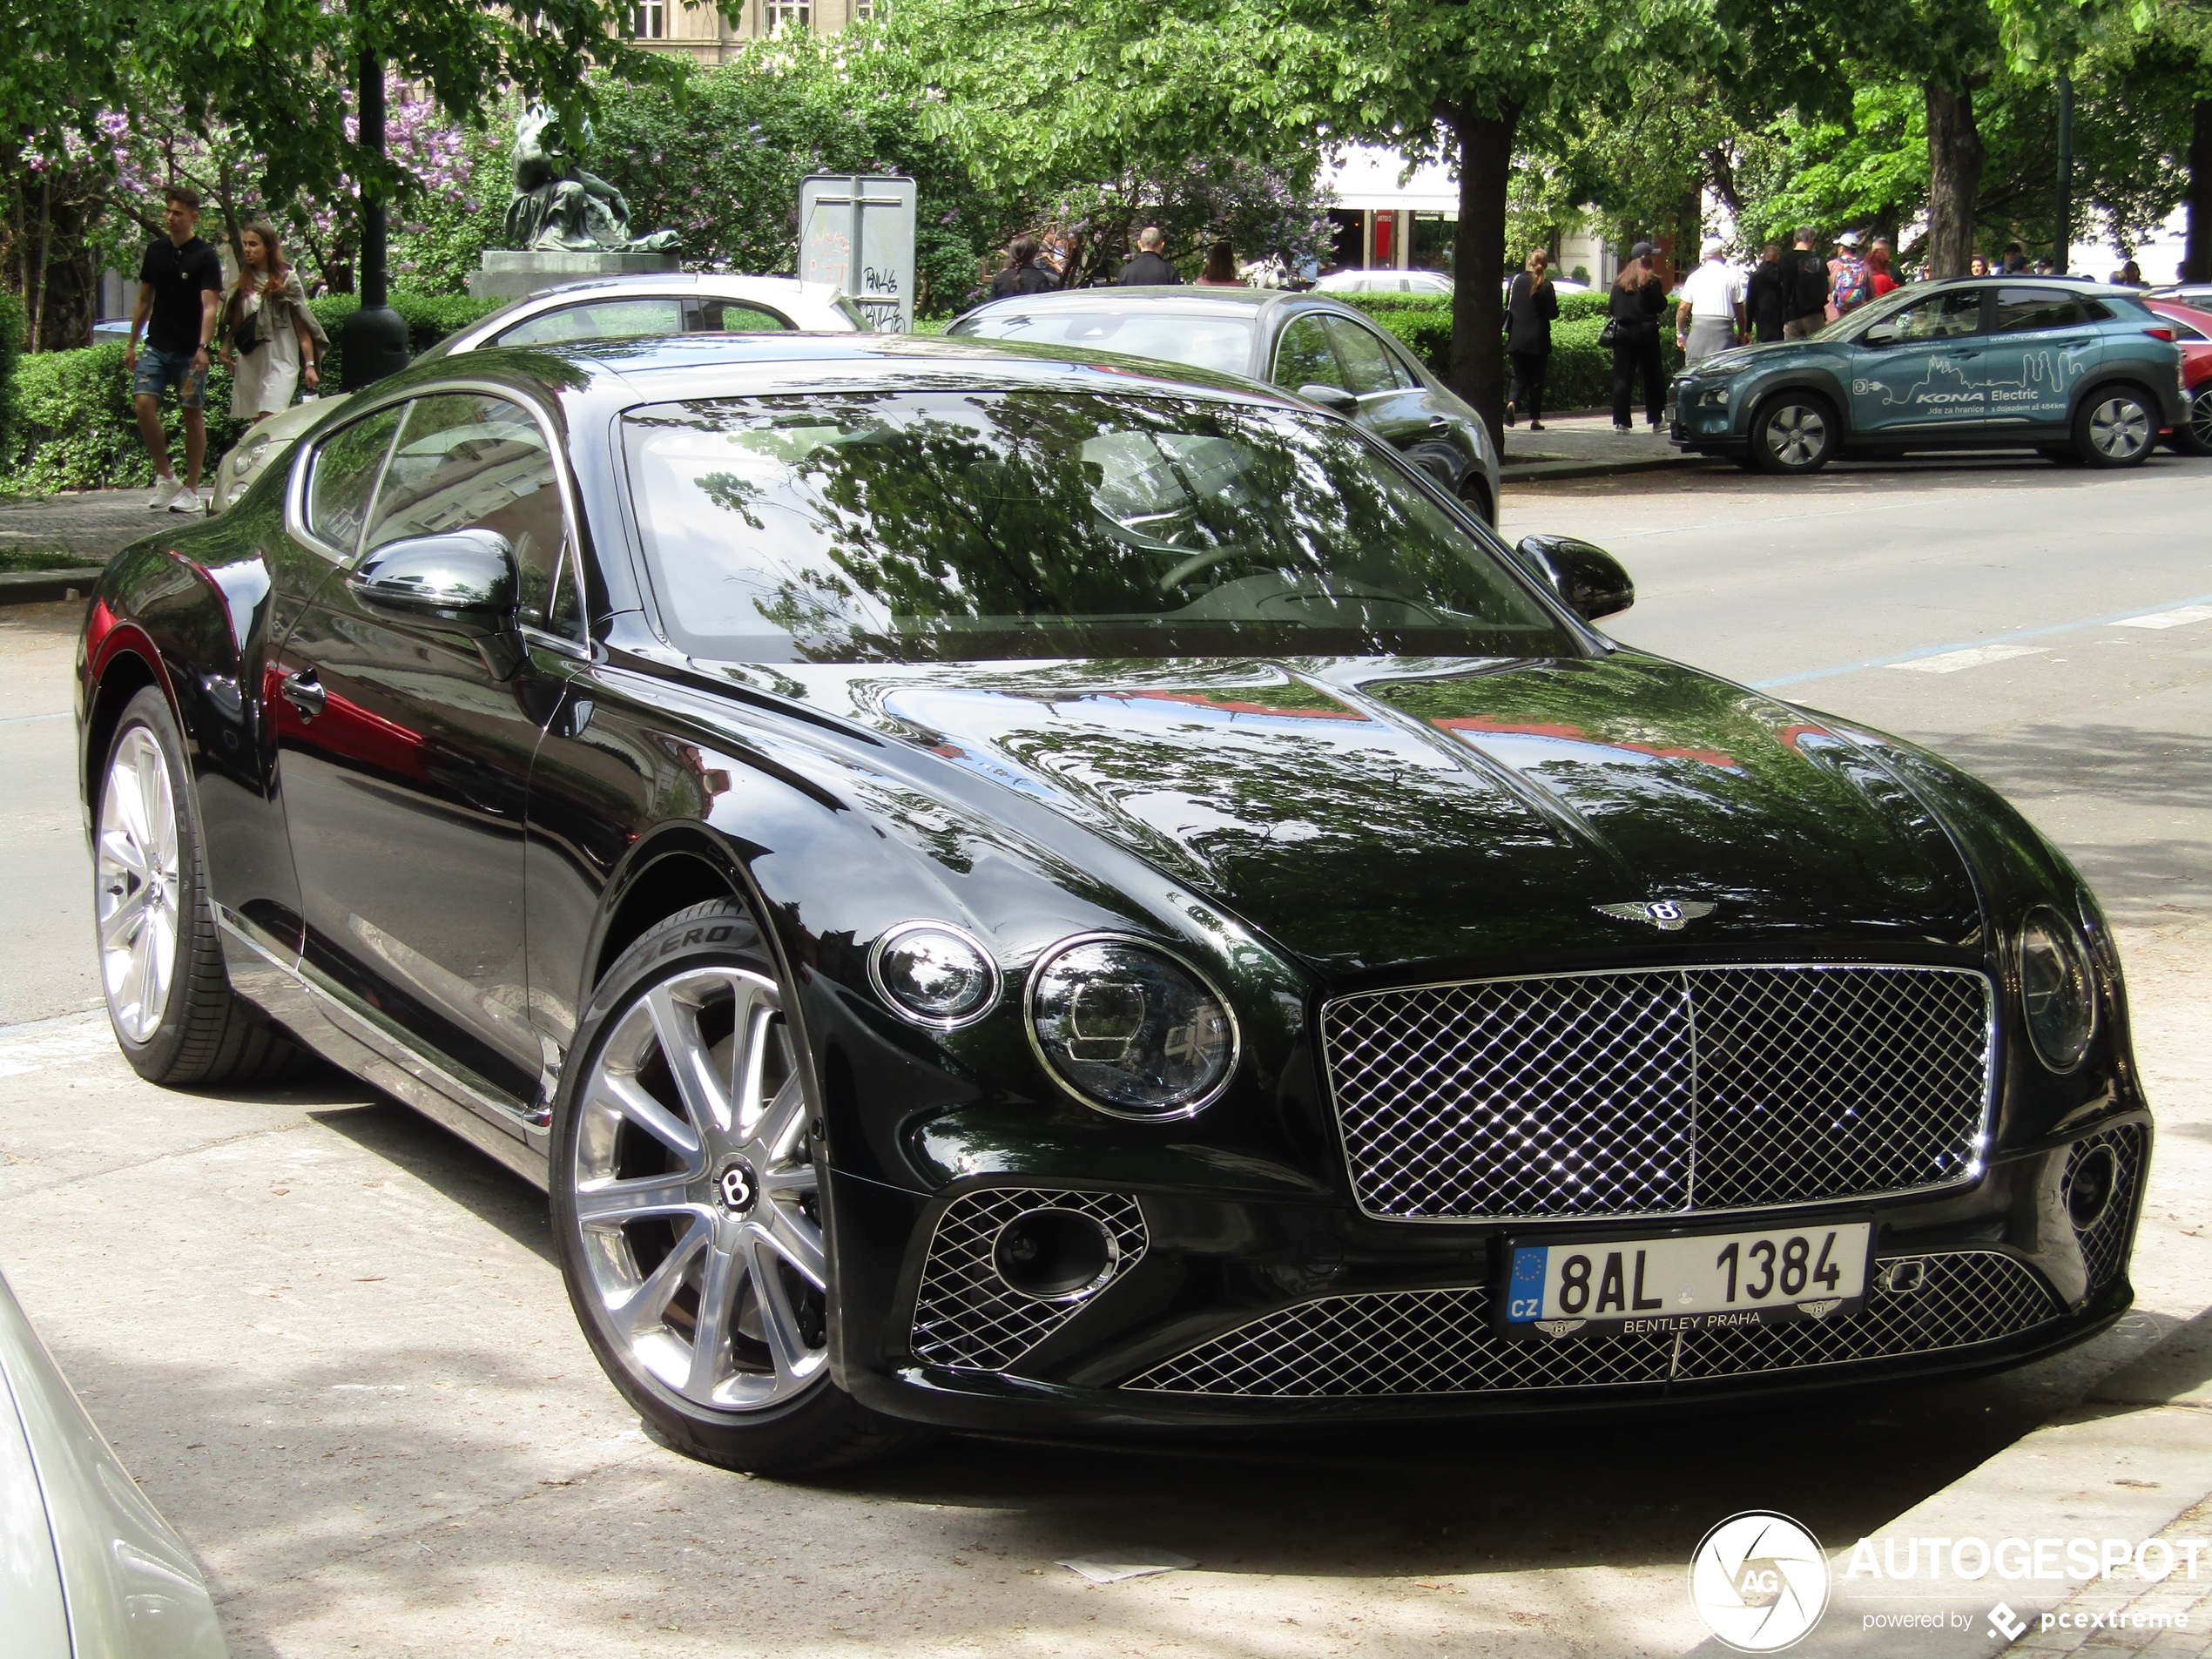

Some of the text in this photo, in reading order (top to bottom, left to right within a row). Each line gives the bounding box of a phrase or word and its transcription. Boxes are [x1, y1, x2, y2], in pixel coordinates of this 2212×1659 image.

[1916, 390, 2039, 404] KONA Electric
[1954, 405, 1985, 414] hranice
[1996, 404, 2029, 413] dojezdem
[637, 926, 735, 971] ZERO
[722, 1170, 750, 1205] B
[1558, 1231, 1841, 1314] 8AL 1384
[1511, 1298, 1538, 1318] CZ
[1623, 1312, 1761, 1333] BENTLEY PRAHA
